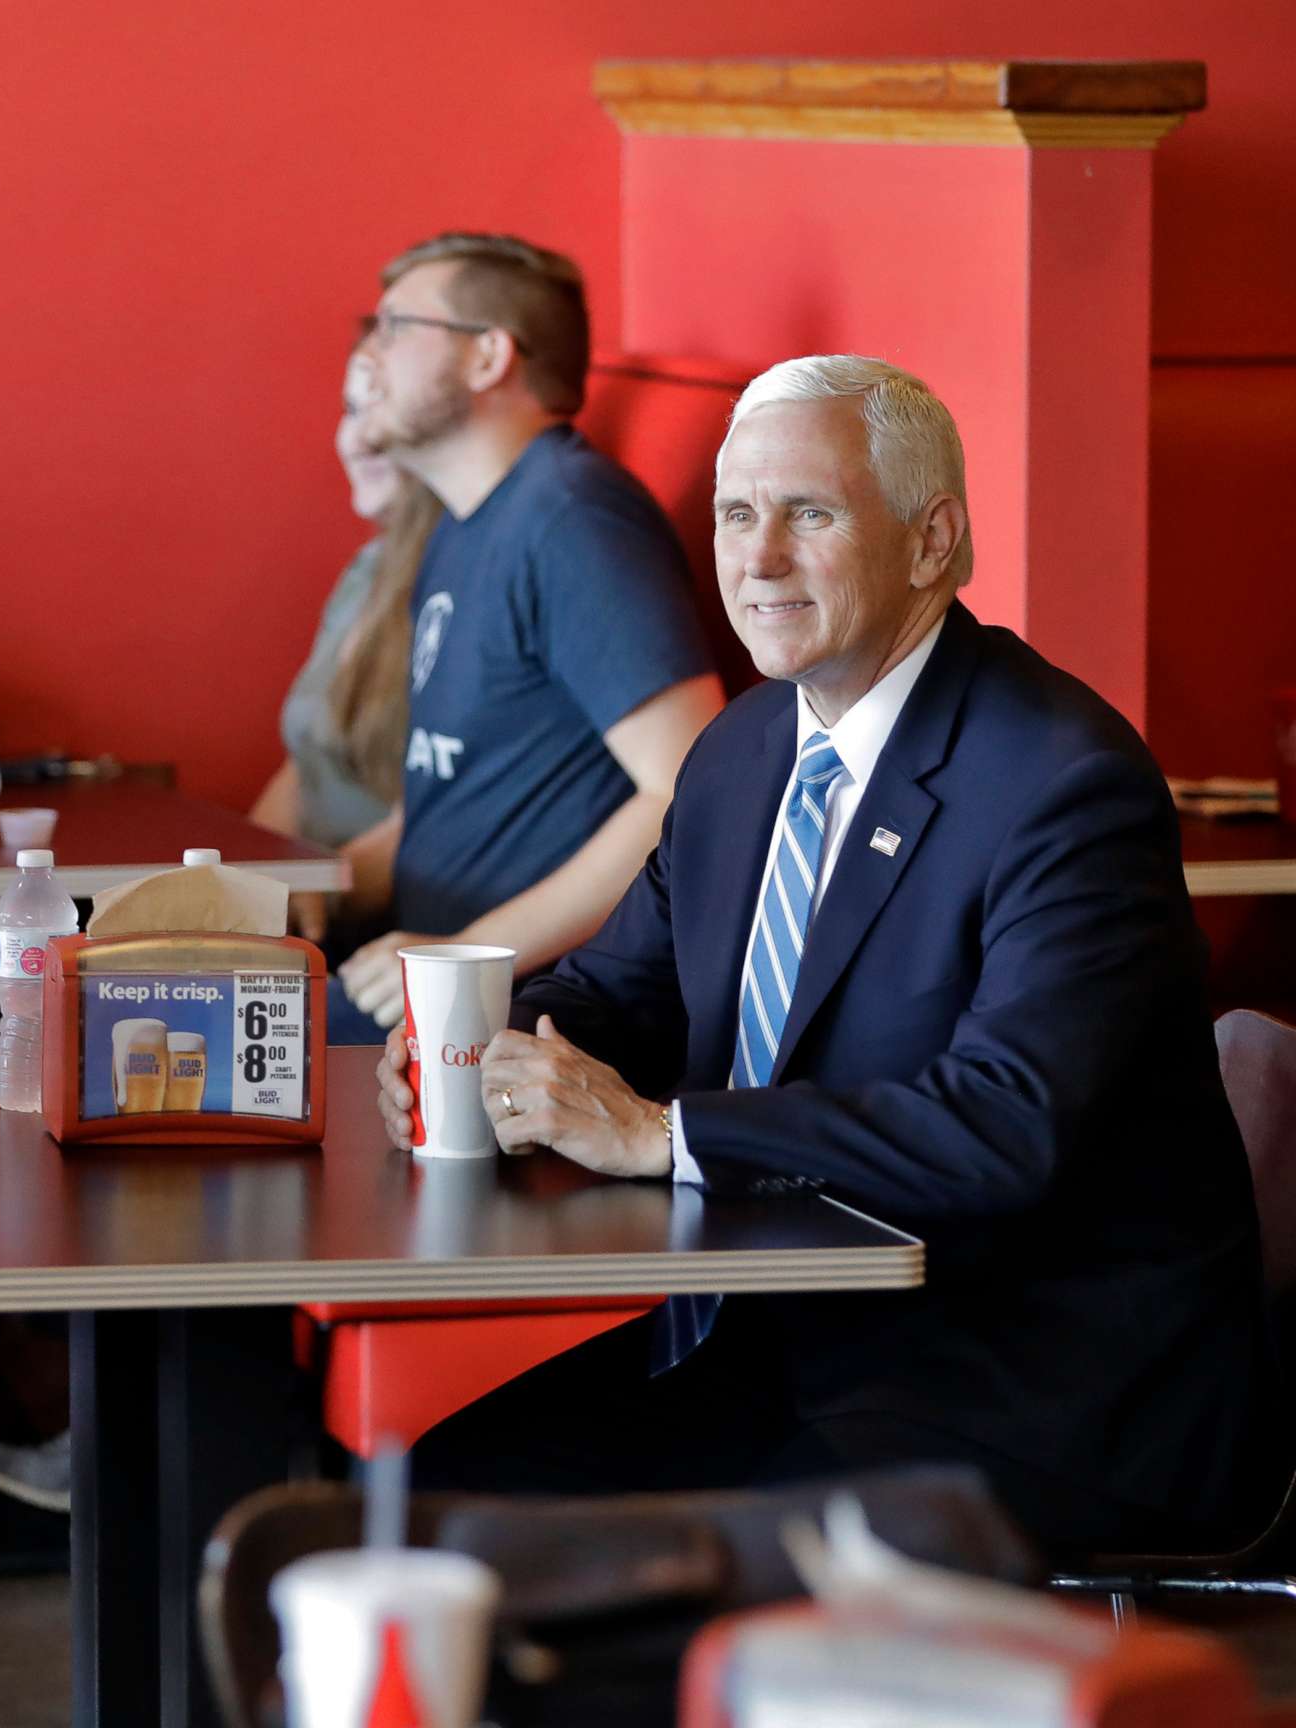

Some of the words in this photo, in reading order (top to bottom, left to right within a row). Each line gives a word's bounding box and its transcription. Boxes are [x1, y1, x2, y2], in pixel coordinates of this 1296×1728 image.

[99, 982, 150, 1003] Keep
[154, 982, 169, 1000] it
[172, 982, 224, 1004] crisp.
[178, 1059, 202, 1068] BUD
[442, 1042, 486, 1068] Cok
